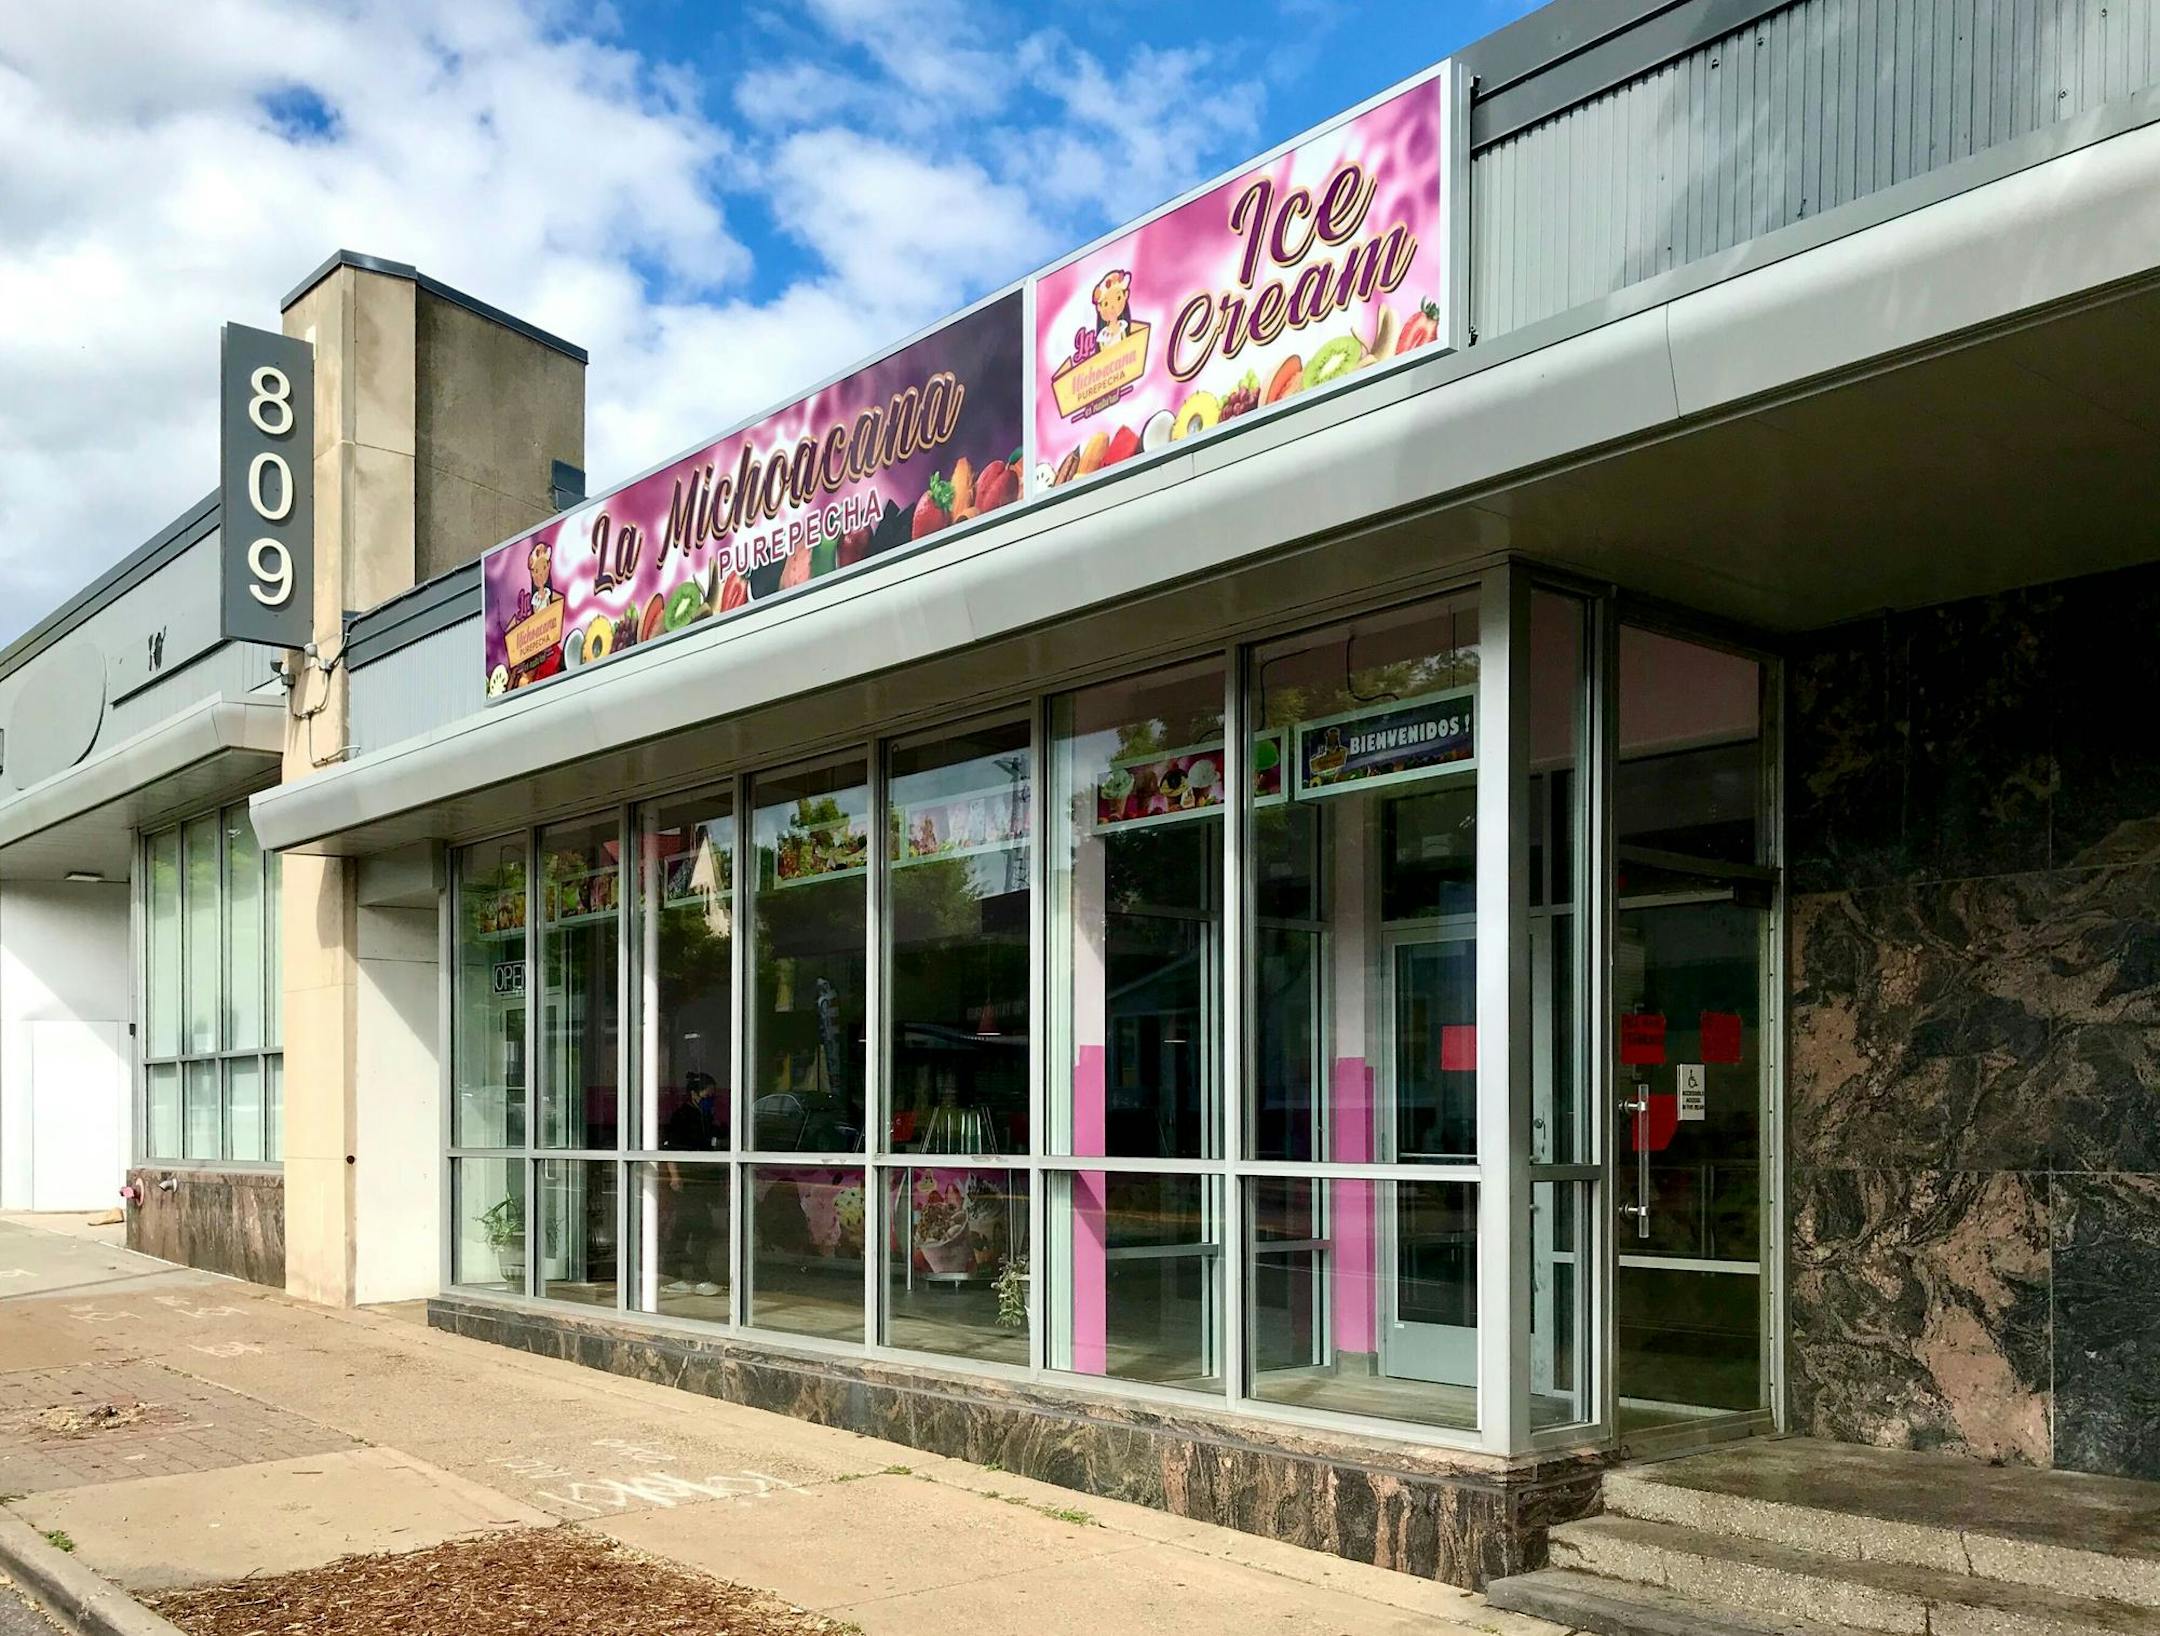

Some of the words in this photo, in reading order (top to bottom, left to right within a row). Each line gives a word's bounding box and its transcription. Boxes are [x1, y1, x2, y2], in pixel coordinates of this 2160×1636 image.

[1230, 161, 1377, 289] Ice
[1073, 326, 1096, 363] La
[1166, 222, 1418, 383] Cream
[1077, 371, 1125, 401] PUREPECHA
[248, 366, 294, 606] 809
[591, 510, 643, 595] La
[656, 370, 966, 570] Michoacana
[716, 486, 885, 584] PUREPECHA
[1350, 715, 1460, 755] BIENVENIDOS
